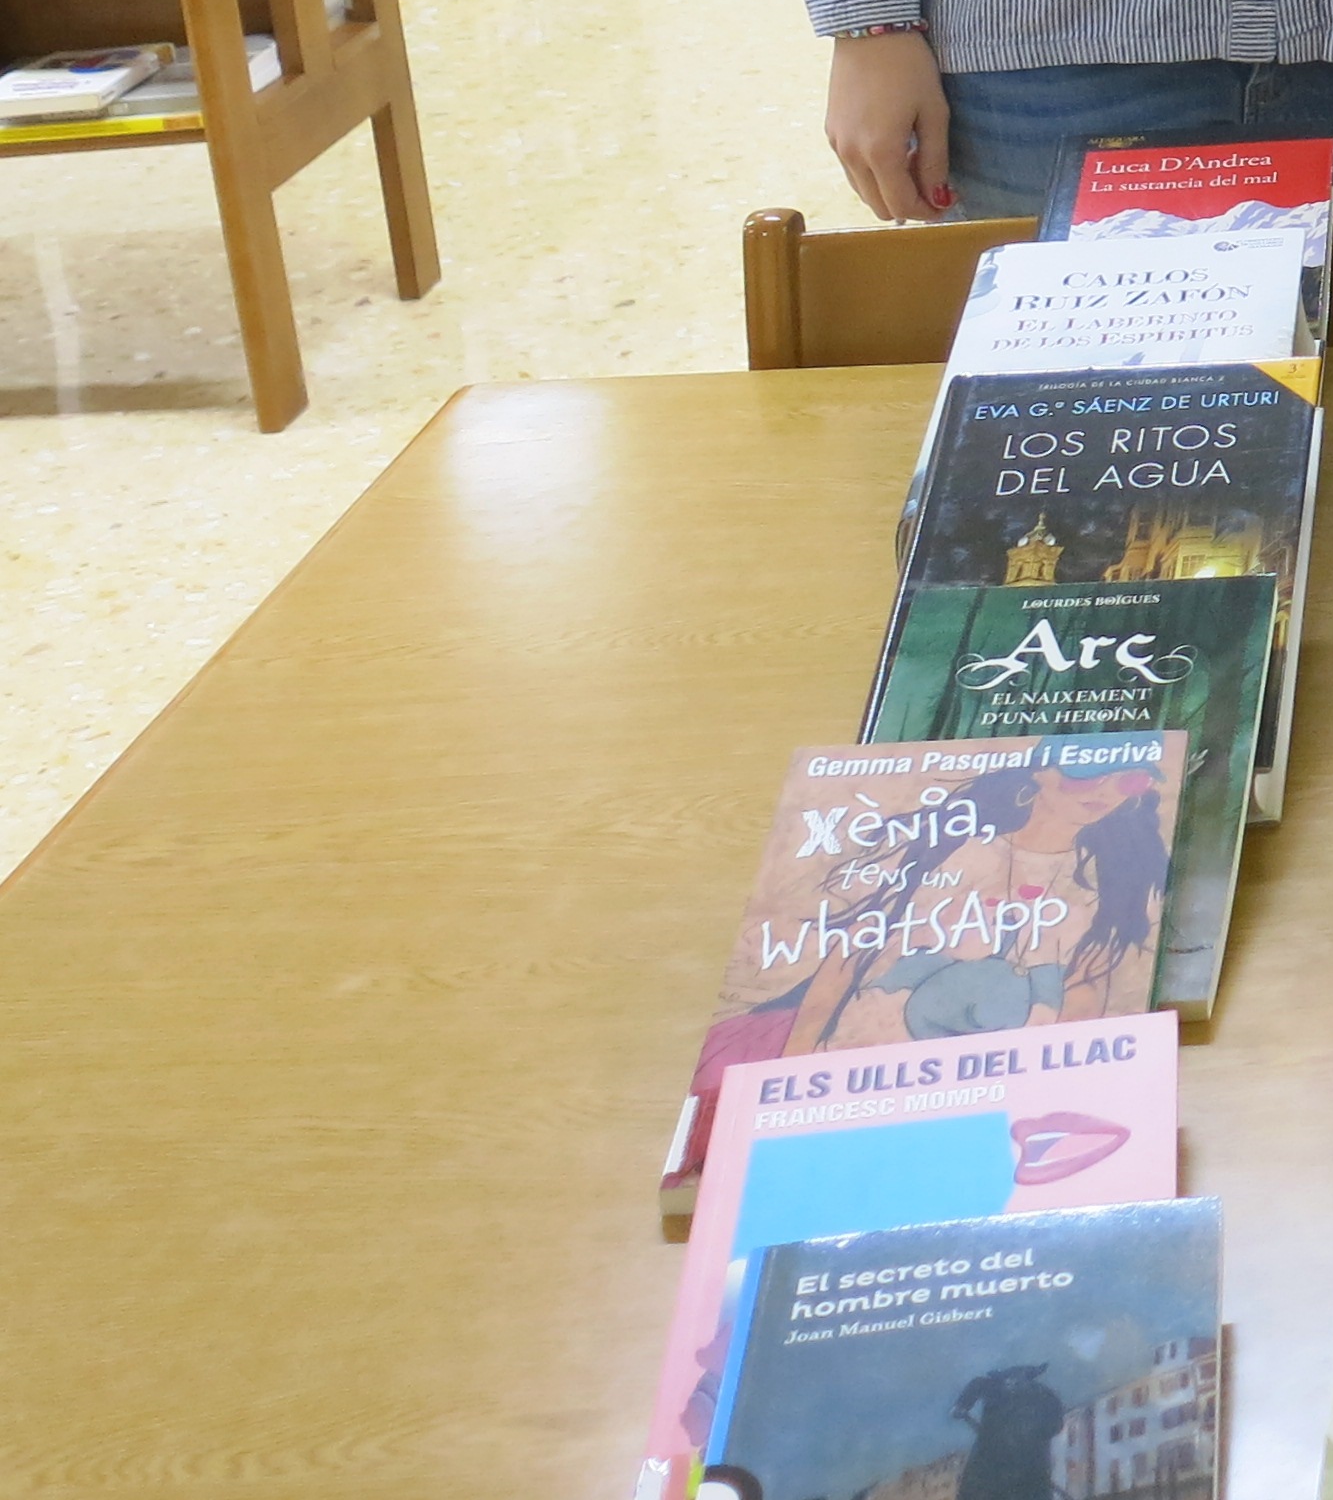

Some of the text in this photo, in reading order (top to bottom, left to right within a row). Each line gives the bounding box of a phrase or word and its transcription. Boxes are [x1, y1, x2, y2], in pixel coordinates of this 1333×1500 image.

[1090, 172, 1278, 192] La sustancia del mal
[1094, 159, 1151, 175] Luca
[975, 391, 1280, 421] EVA SÁENZ DE URTURI
[1002, 422, 1238, 460] LOS RITOS
[995, 460, 1231, 497] DEL AGUA
[1021, 687, 1150, 705] NAIXEMENT
[808, 742, 1163, 778] Gemma Pasqual i Escrivà
[758, 1033, 1137, 1105] ELS ULLS DEL LLAC
[754, 1082, 1006, 1130] FRANCESC MOMPÓ
[796, 1248, 1035, 1296] El secreto del
[790, 1267, 1074, 1321] hombre muerto
[784, 1305, 994, 1346] Joan Manuel Gisbert
